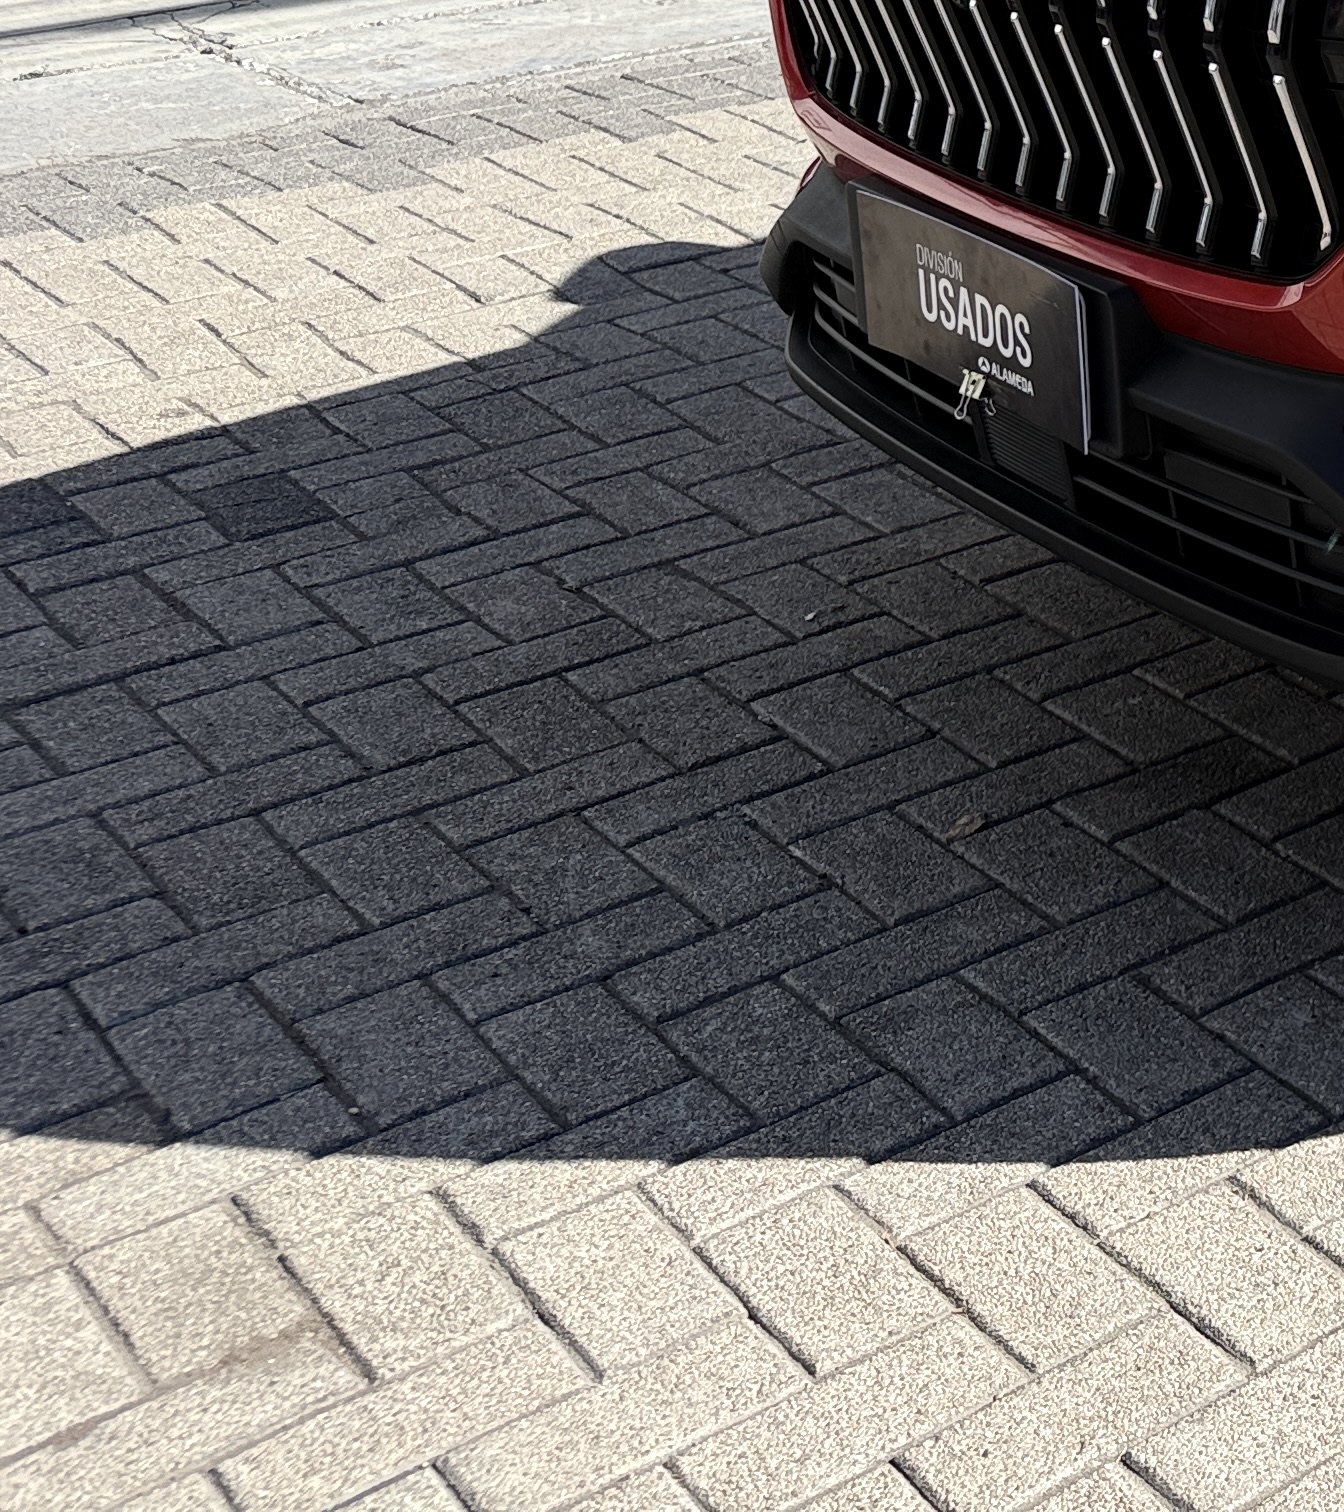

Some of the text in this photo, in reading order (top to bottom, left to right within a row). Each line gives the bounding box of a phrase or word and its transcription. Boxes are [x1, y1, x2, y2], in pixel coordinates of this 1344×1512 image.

[915, 243, 963, 283] DIVISIÓN
[918, 268, 1033, 368] USADOS
[990, 361, 1035, 397] ALAMEDA
